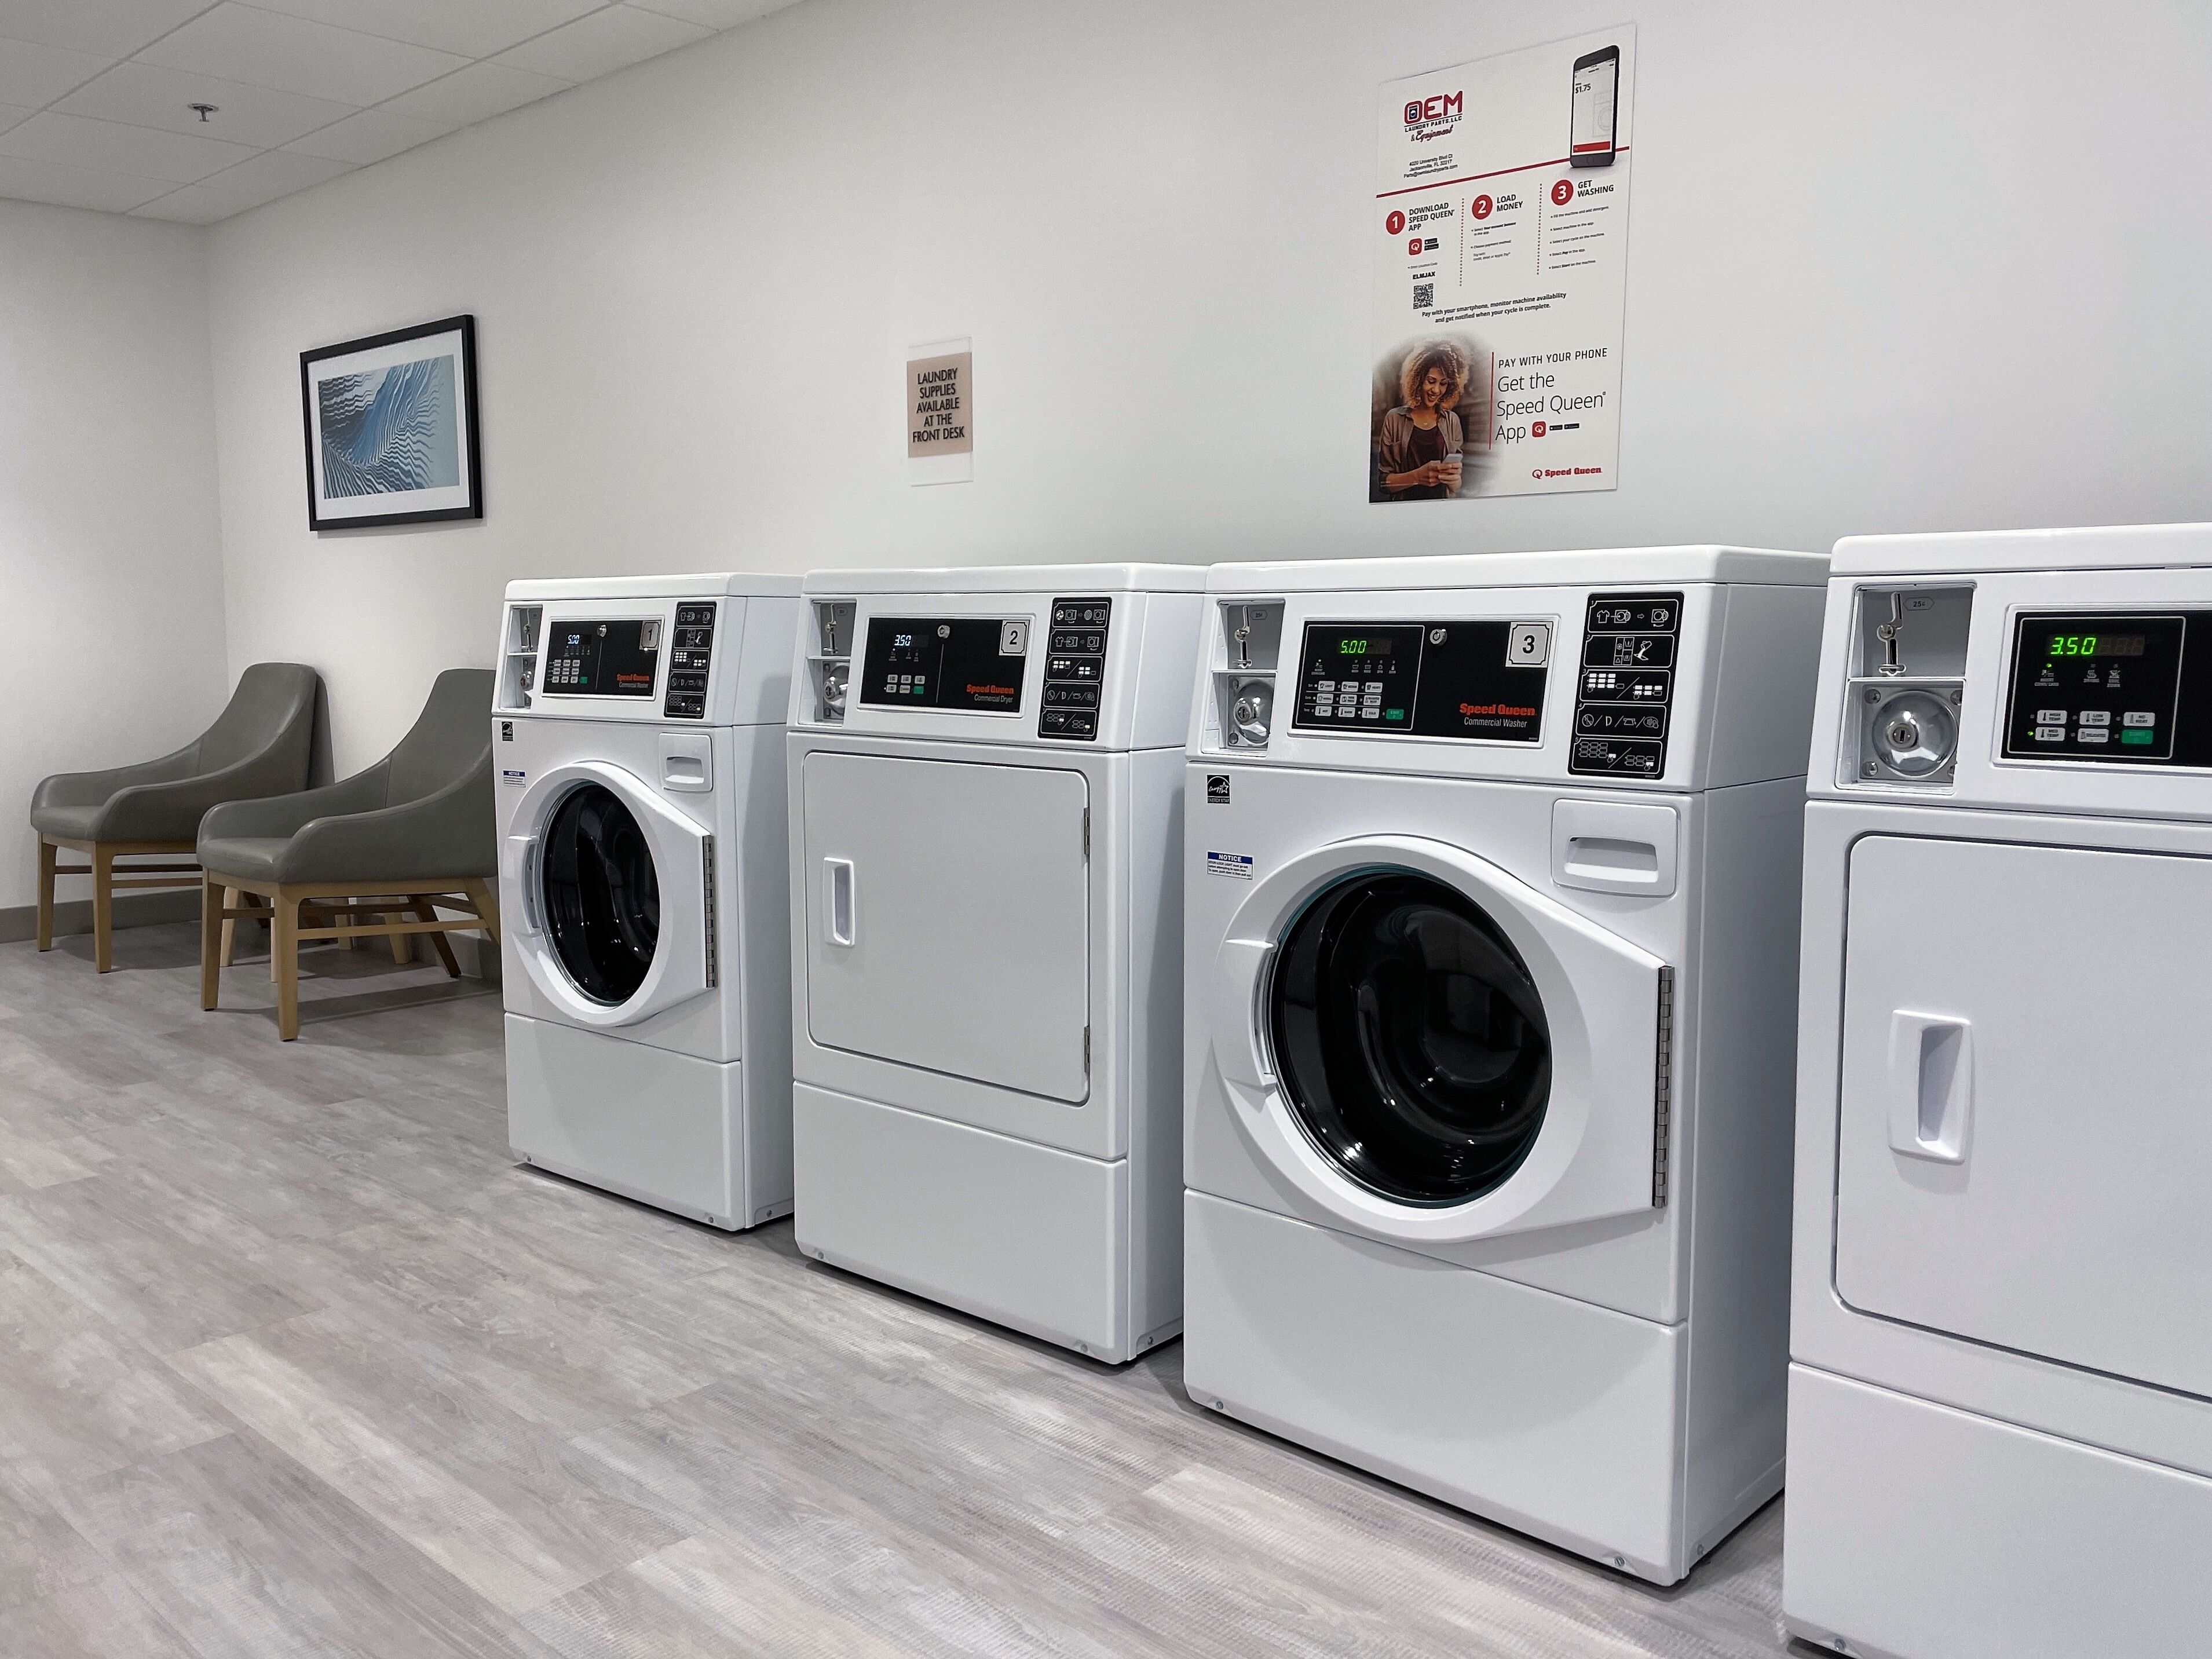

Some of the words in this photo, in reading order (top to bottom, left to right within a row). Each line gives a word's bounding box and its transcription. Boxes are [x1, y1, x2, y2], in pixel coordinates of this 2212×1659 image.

[1575, 83, 1591, 93] $1.75
[1405, 91, 1463, 124] OEM
[1405, 124, 1428, 132] LAUNDRY
[1578, 180, 1592, 188] GET
[1557, 185, 1567, 199] 3
[1578, 185, 1614, 197] WASHING
[1497, 194, 1516, 203] LOAD
[1409, 203, 1449, 215] DOWNLOAD
[1478, 200, 1486, 214] 2
[1497, 201, 1523, 212] MONEY
[1392, 216, 1398, 229] 1
[1409, 214, 1428, 223] SPEED
[1537, 293, 1566, 302] availability
[1505, 306, 1518, 315] cycle
[1524, 303, 1551, 311] complete.
[1498, 359, 1516, 368] PAY
[1519, 355, 1542, 366] WITH
[1546, 352, 1571, 363] YOUR
[1575, 348, 1608, 360] PHONE
[917, 368, 957, 385] LAUNDRY
[1498, 376, 1524, 392] Get
[1530, 372, 1555, 389] the
[919, 383, 956, 399] SUPPLIES
[916, 397, 959, 414] AVAILABLE
[1497, 396, 1544, 420] Speed
[924, 415, 934, 427] AT
[937, 413, 952, 425] THE
[913, 429, 940, 443] FRONT
[944, 426, 965, 439] DESK
[1495, 425, 1526, 444] App
[1545, 468, 1571, 477] Speed
[649, 628, 652, 641] 1
[1010, 630, 1018, 645] 2
[1341, 641, 1366, 653] 5.00
[1523, 635, 1535, 653] 3
[2050, 637, 2097, 656] 3.50
[967, 684, 989, 693] Speed
[990, 685, 1014, 694] Queen
[974, 694, 1000, 702] Commercial
[1001, 696, 1013, 704] Dryer
[1460, 703, 1496, 715] Speed
[1498, 704, 1535, 715] Queen
[1464, 717, 1501, 726] Commercial
[1503, 719, 1527, 728] Washer
